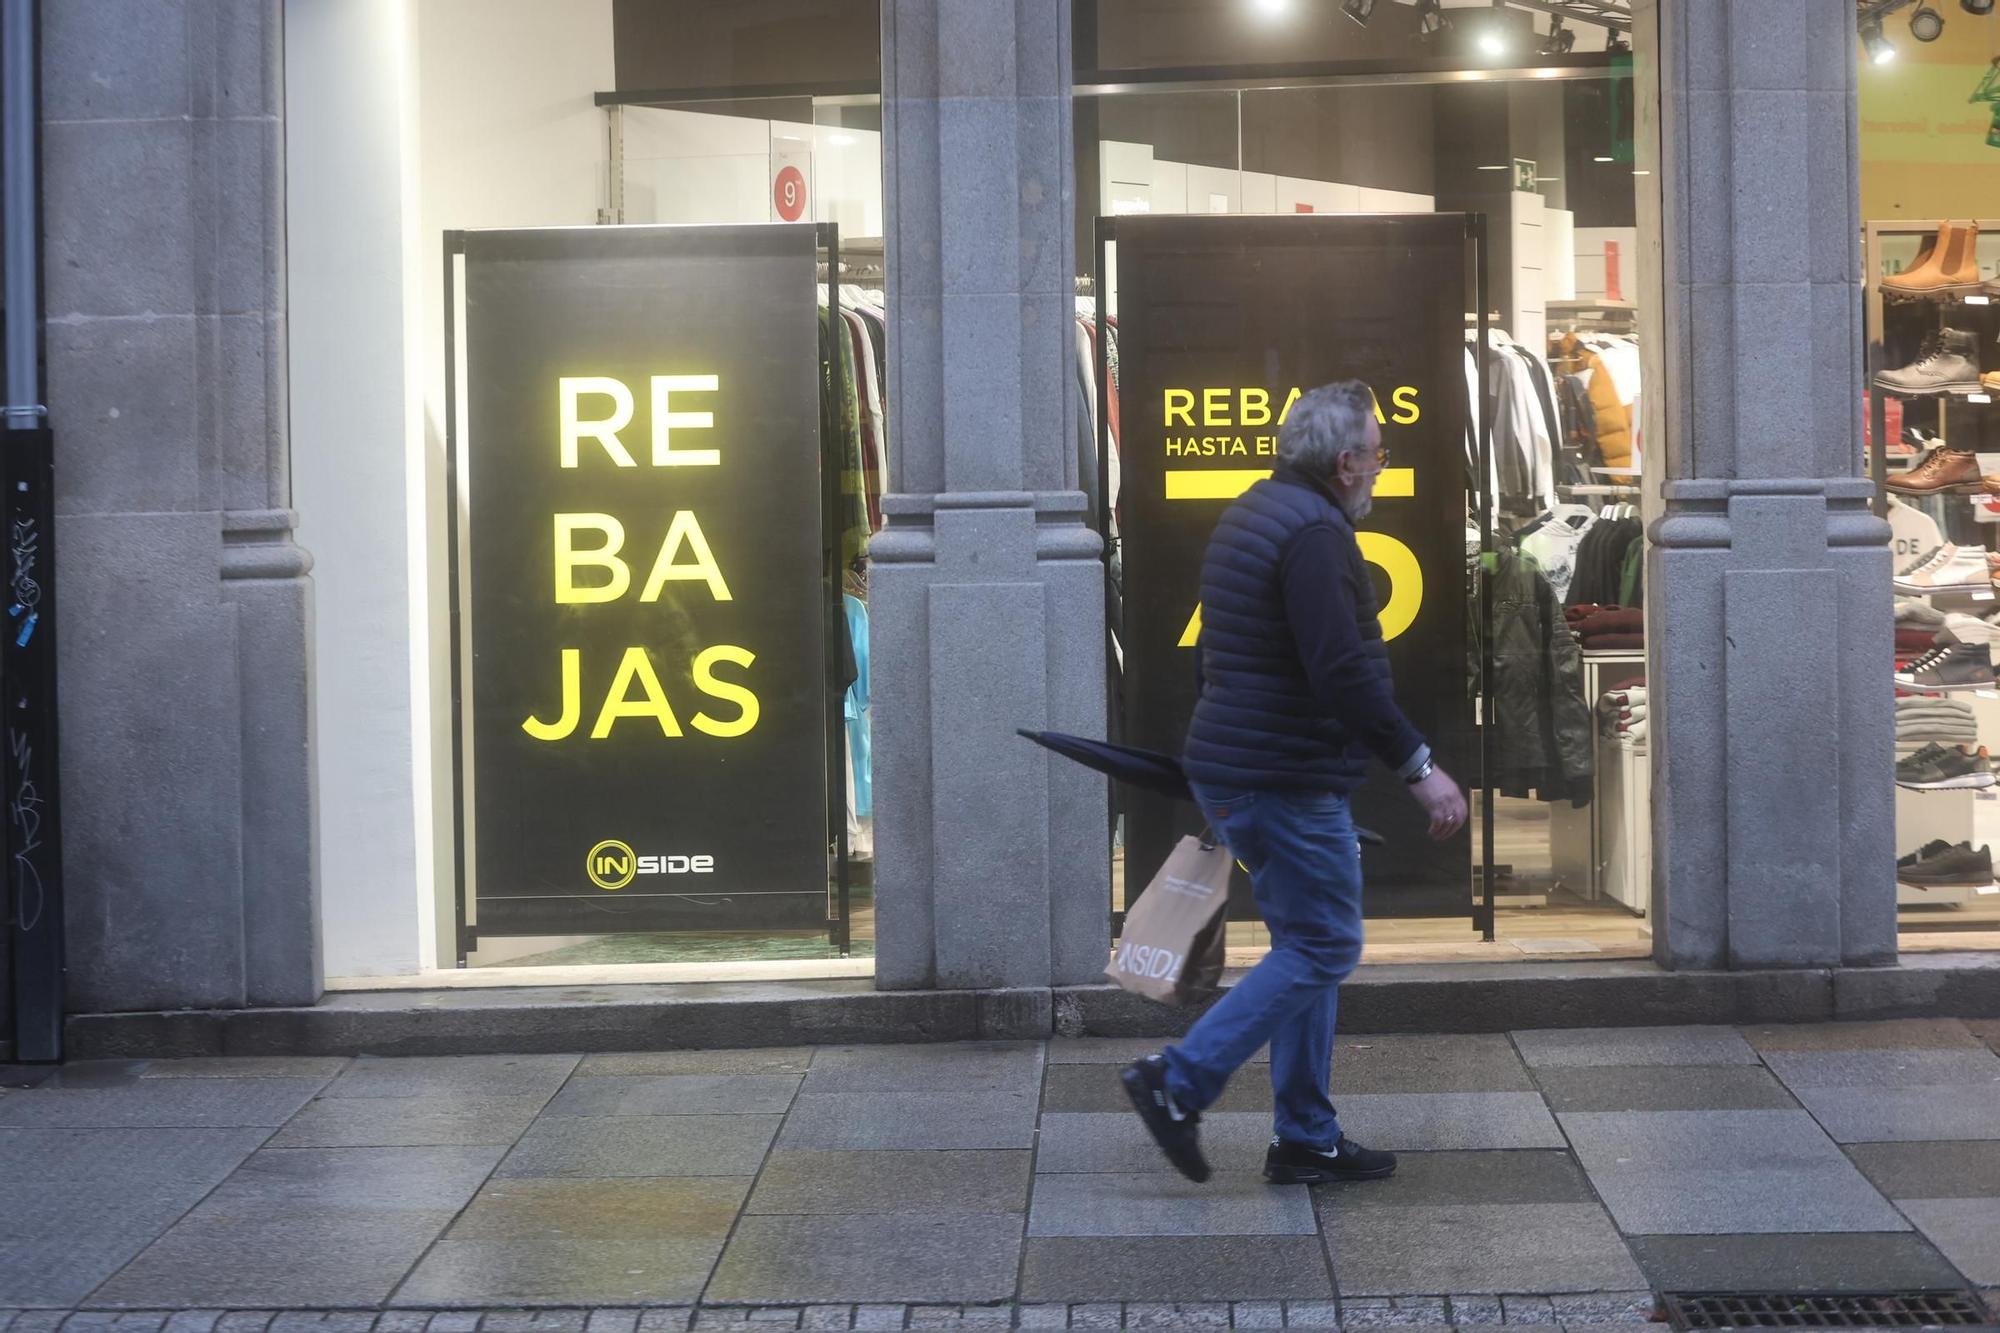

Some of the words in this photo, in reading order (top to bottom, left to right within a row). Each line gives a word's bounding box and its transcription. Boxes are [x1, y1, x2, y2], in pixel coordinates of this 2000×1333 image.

[558, 374, 721, 469] RE
[1163, 385, 1421, 428] REBAS
[1165, 436, 1249, 456] HASTA
[553, 510, 734, 604] BA
[520, 644, 761, 742] JAS
